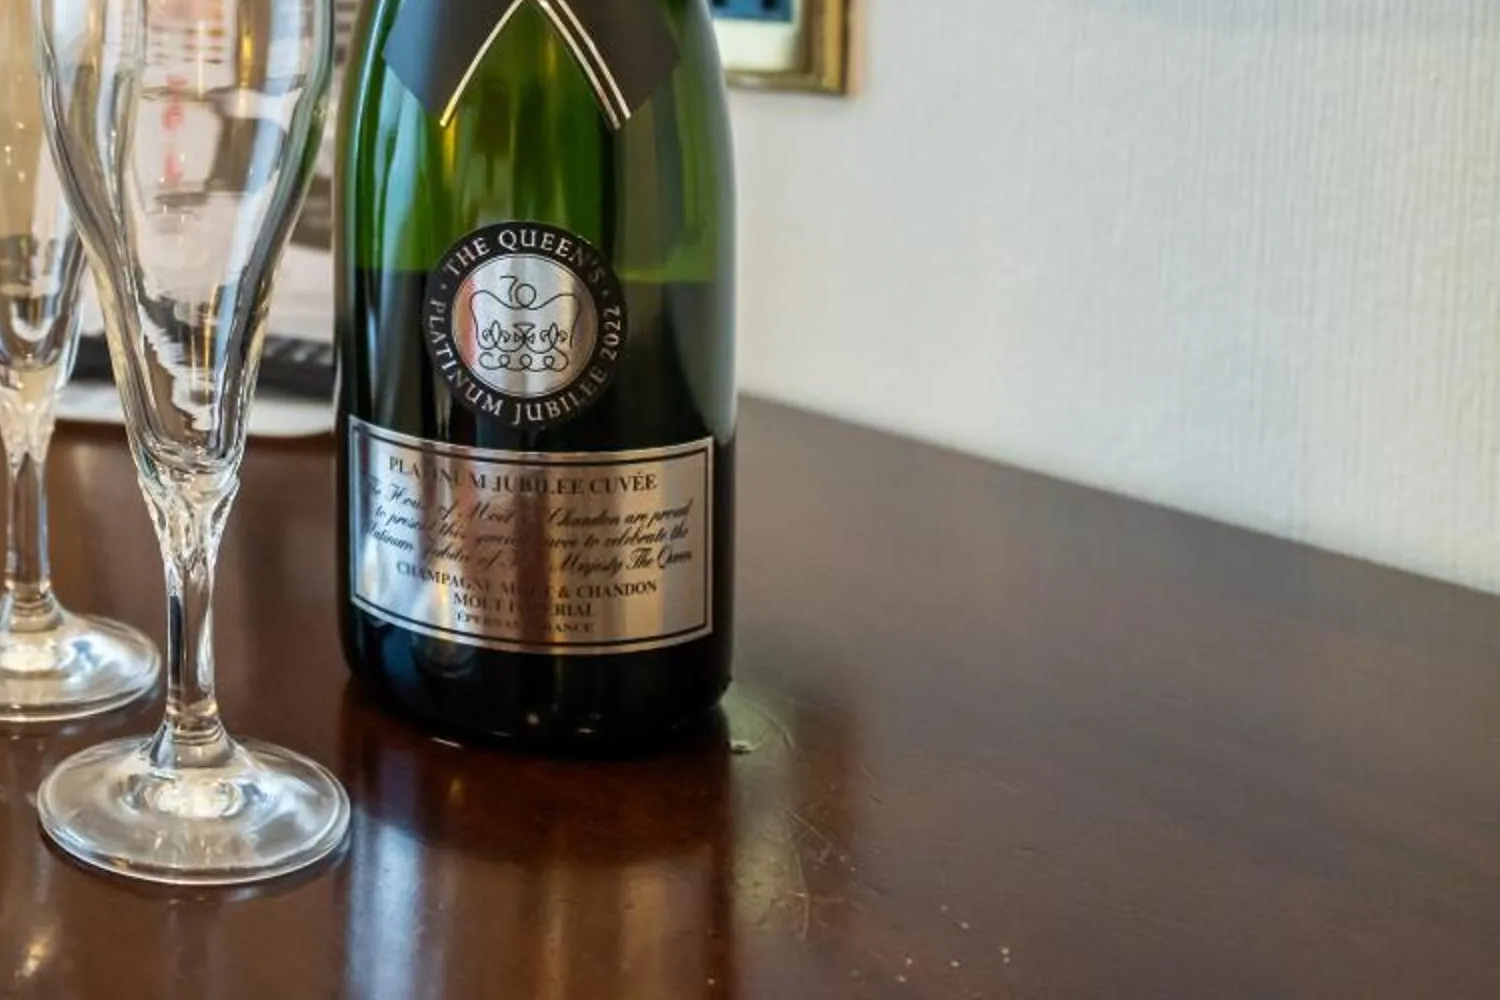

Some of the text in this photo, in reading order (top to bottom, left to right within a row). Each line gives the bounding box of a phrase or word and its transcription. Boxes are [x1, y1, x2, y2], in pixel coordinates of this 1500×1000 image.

[443, 229, 606, 283] THE QUEEN'S
[429, 298, 621, 425] PLATINUM JUBILEE 2022
[389, 456, 486, 489] PLAINUM
[589, 472, 657, 494] CUVÉE
[548, 508, 619, 527] Chandon
[624, 512, 648, 526] are
[647, 498, 694, 528] proud
[583, 534, 600, 547] to
[604, 527, 668, 547] celebrate
[669, 520, 689, 541] the
[625, 547, 654, 570] The
[656, 545, 693, 570] Queen
[558, 585, 570, 598] &
[576, 580, 657, 599] CHANDON
